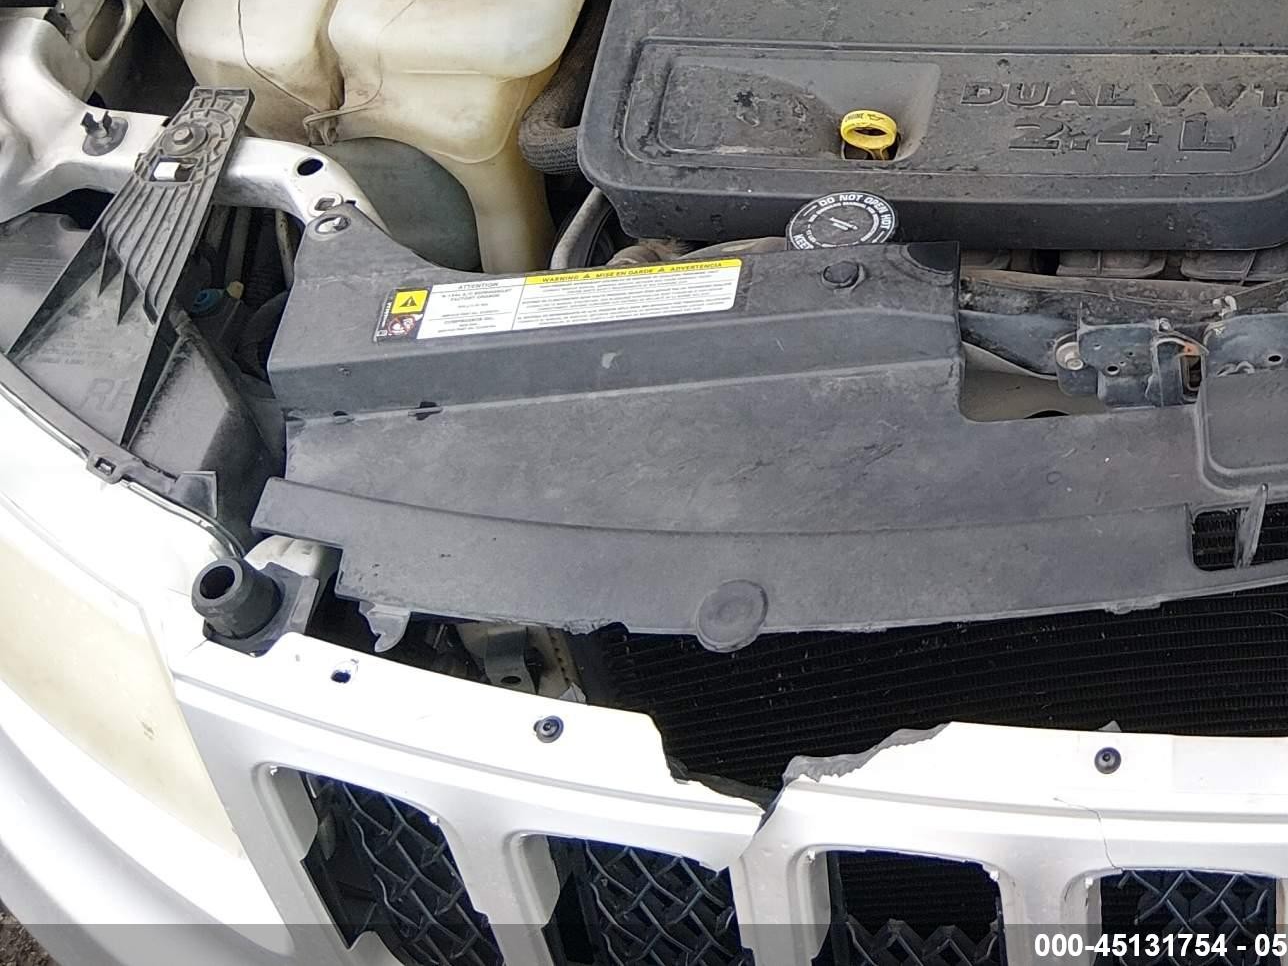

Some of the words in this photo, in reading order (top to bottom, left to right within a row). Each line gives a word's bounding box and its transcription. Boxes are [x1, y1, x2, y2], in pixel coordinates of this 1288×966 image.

[960, 82, 1136, 107] DUAL
[818, 197, 835, 207] DO
[839, 194, 863, 202] NOT
[863, 197, 889, 214] OPEN
